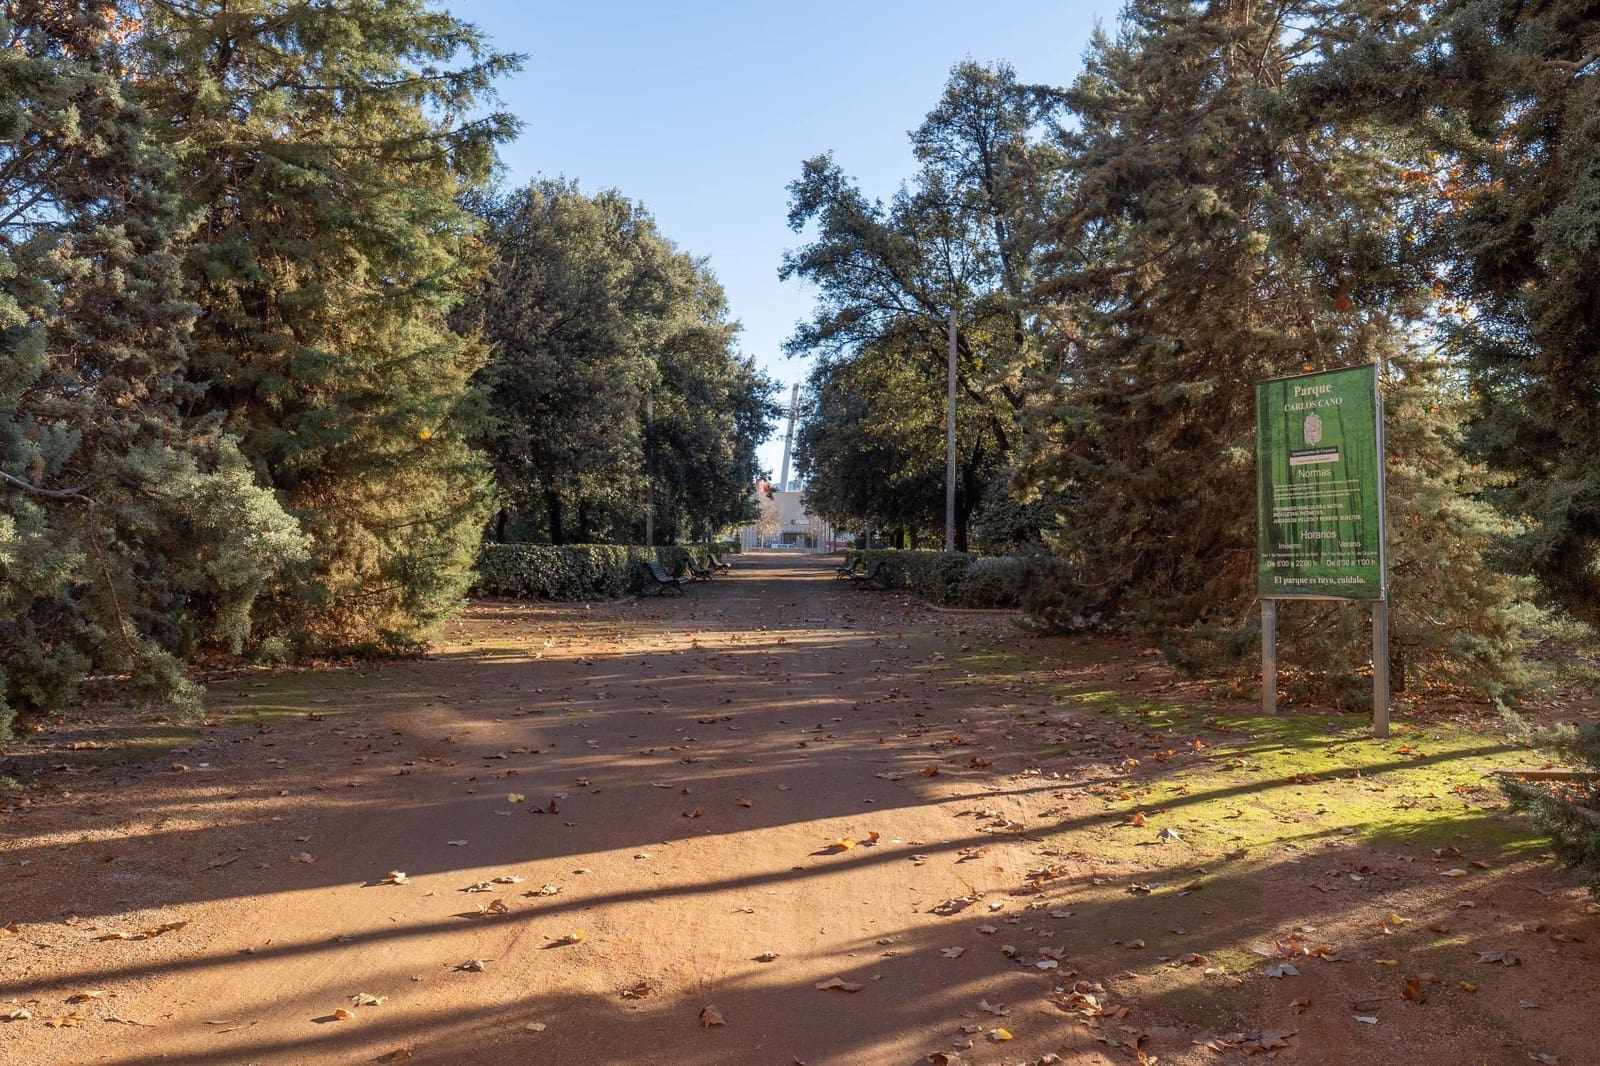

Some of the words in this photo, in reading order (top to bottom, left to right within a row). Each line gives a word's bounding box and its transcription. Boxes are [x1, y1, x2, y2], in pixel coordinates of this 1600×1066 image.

[1294, 384, 1332, 397] Parque
[1284, 401, 1317, 412] CARLOS
[1318, 398, 1342, 406] CANO
[1298, 469, 1331, 478] Normas
[1301, 530, 1337, 539] Horarios
[1274, 576, 1282, 584] El
[1283, 577, 1308, 585] parque
[1318, 576, 1336, 585] tuyo,
